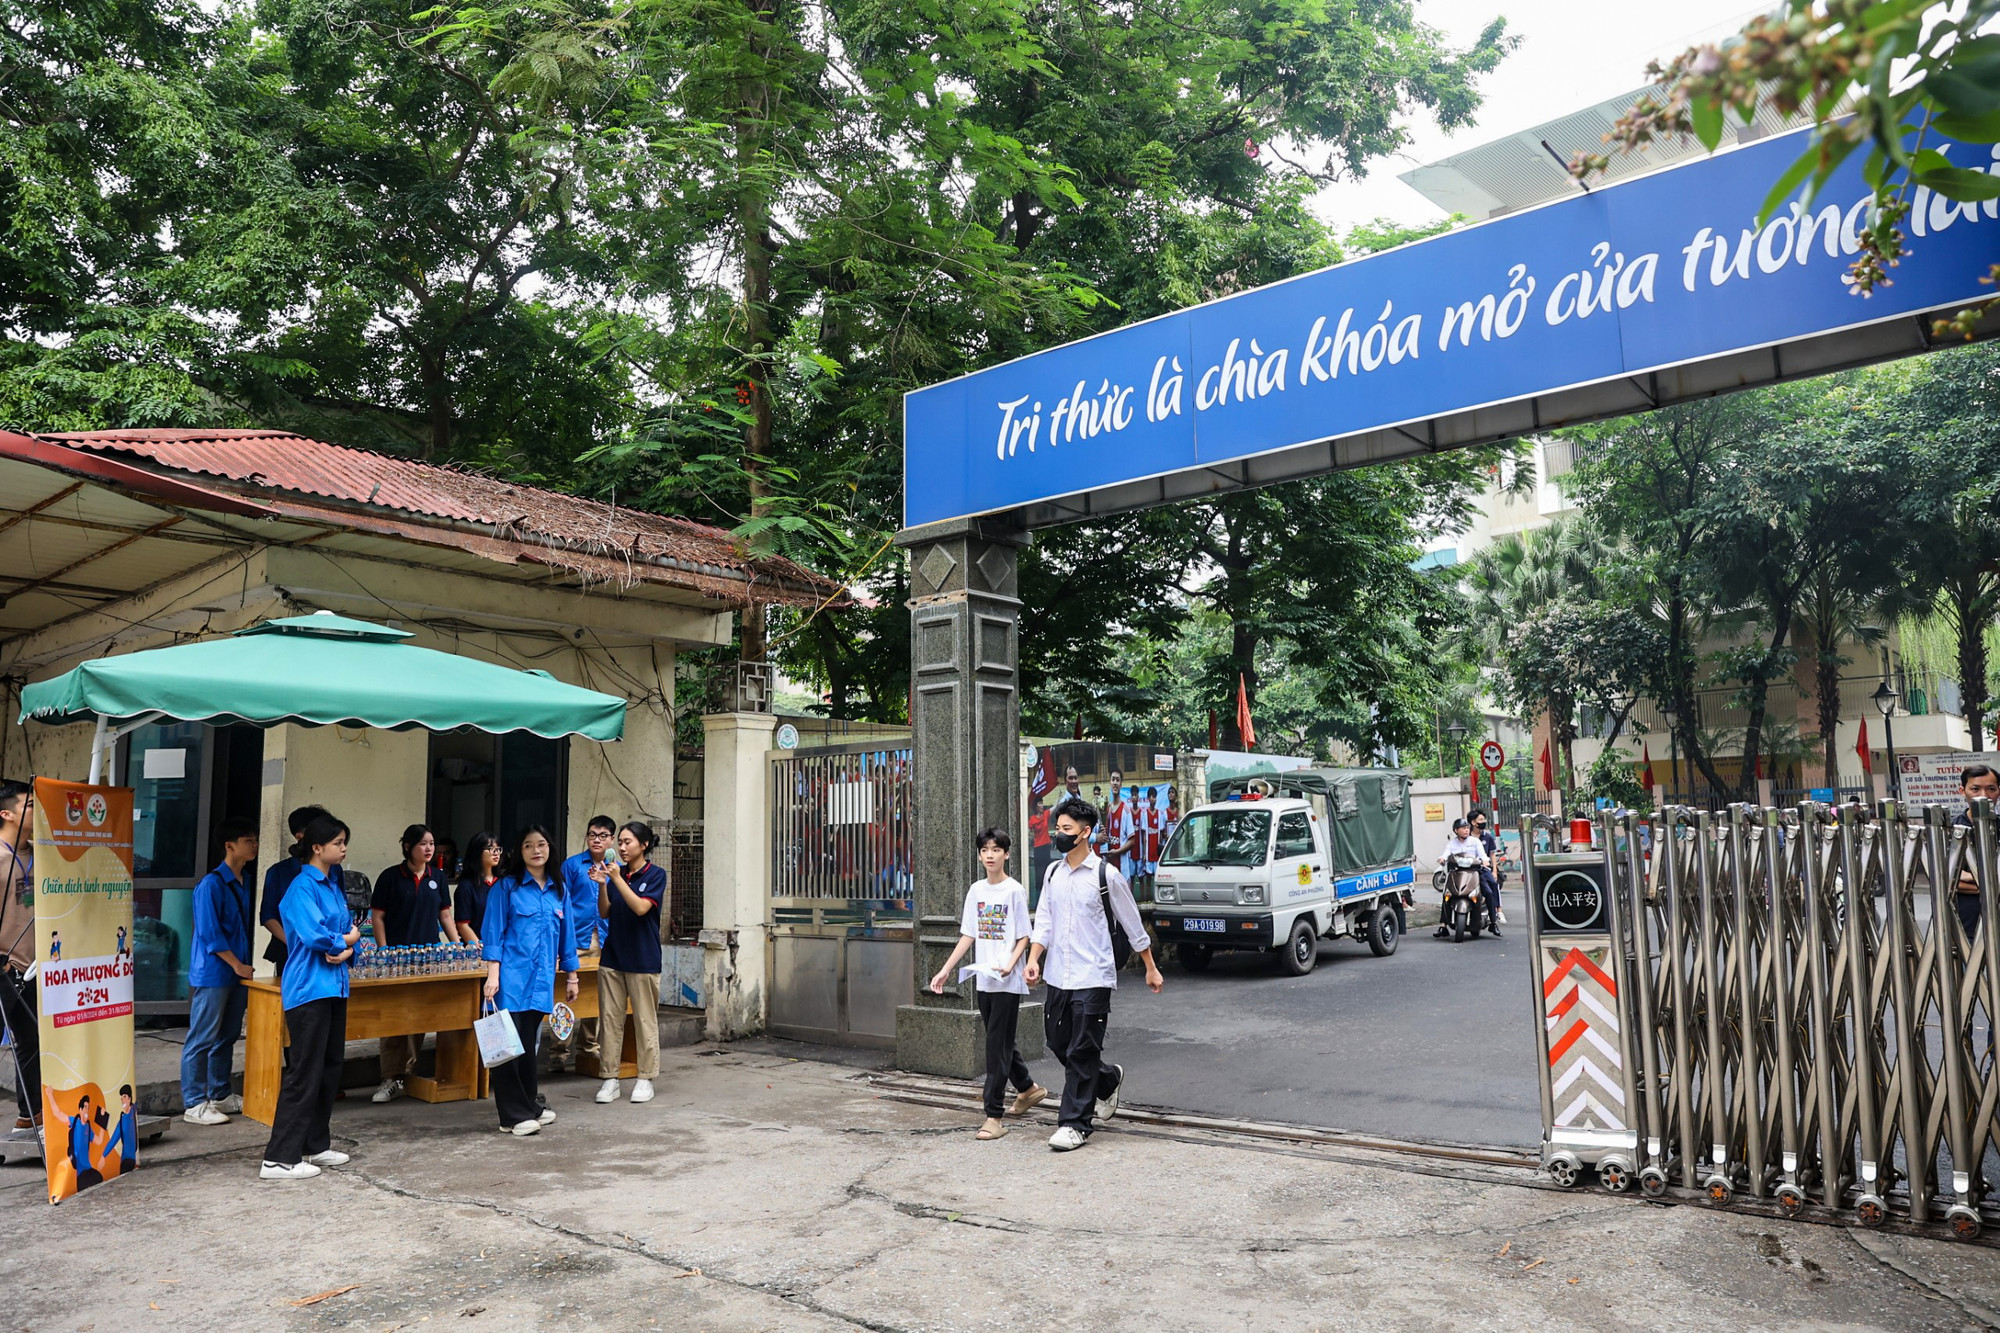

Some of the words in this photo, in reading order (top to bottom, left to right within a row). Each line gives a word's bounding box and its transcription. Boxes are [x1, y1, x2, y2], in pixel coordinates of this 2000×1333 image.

[997, 394, 1040, 461] Tri
[1050, 378, 1134, 447] thức
[1146, 355, 1184, 423] là
[1195, 338, 1288, 412] chìa
[1300, 299, 1422, 387] khóa
[1438, 263, 1536, 352] mở
[1545, 241, 1659, 326] cửa
[42, 876, 63, 895] Chiến
[65, 876, 83, 896] dịch
[102, 878, 132, 900] nguyện
[1548, 891, 1597, 908] 出入平安
[44, 969, 69, 987] HOA
[72, 963, 120, 983] PHƯỢNG
